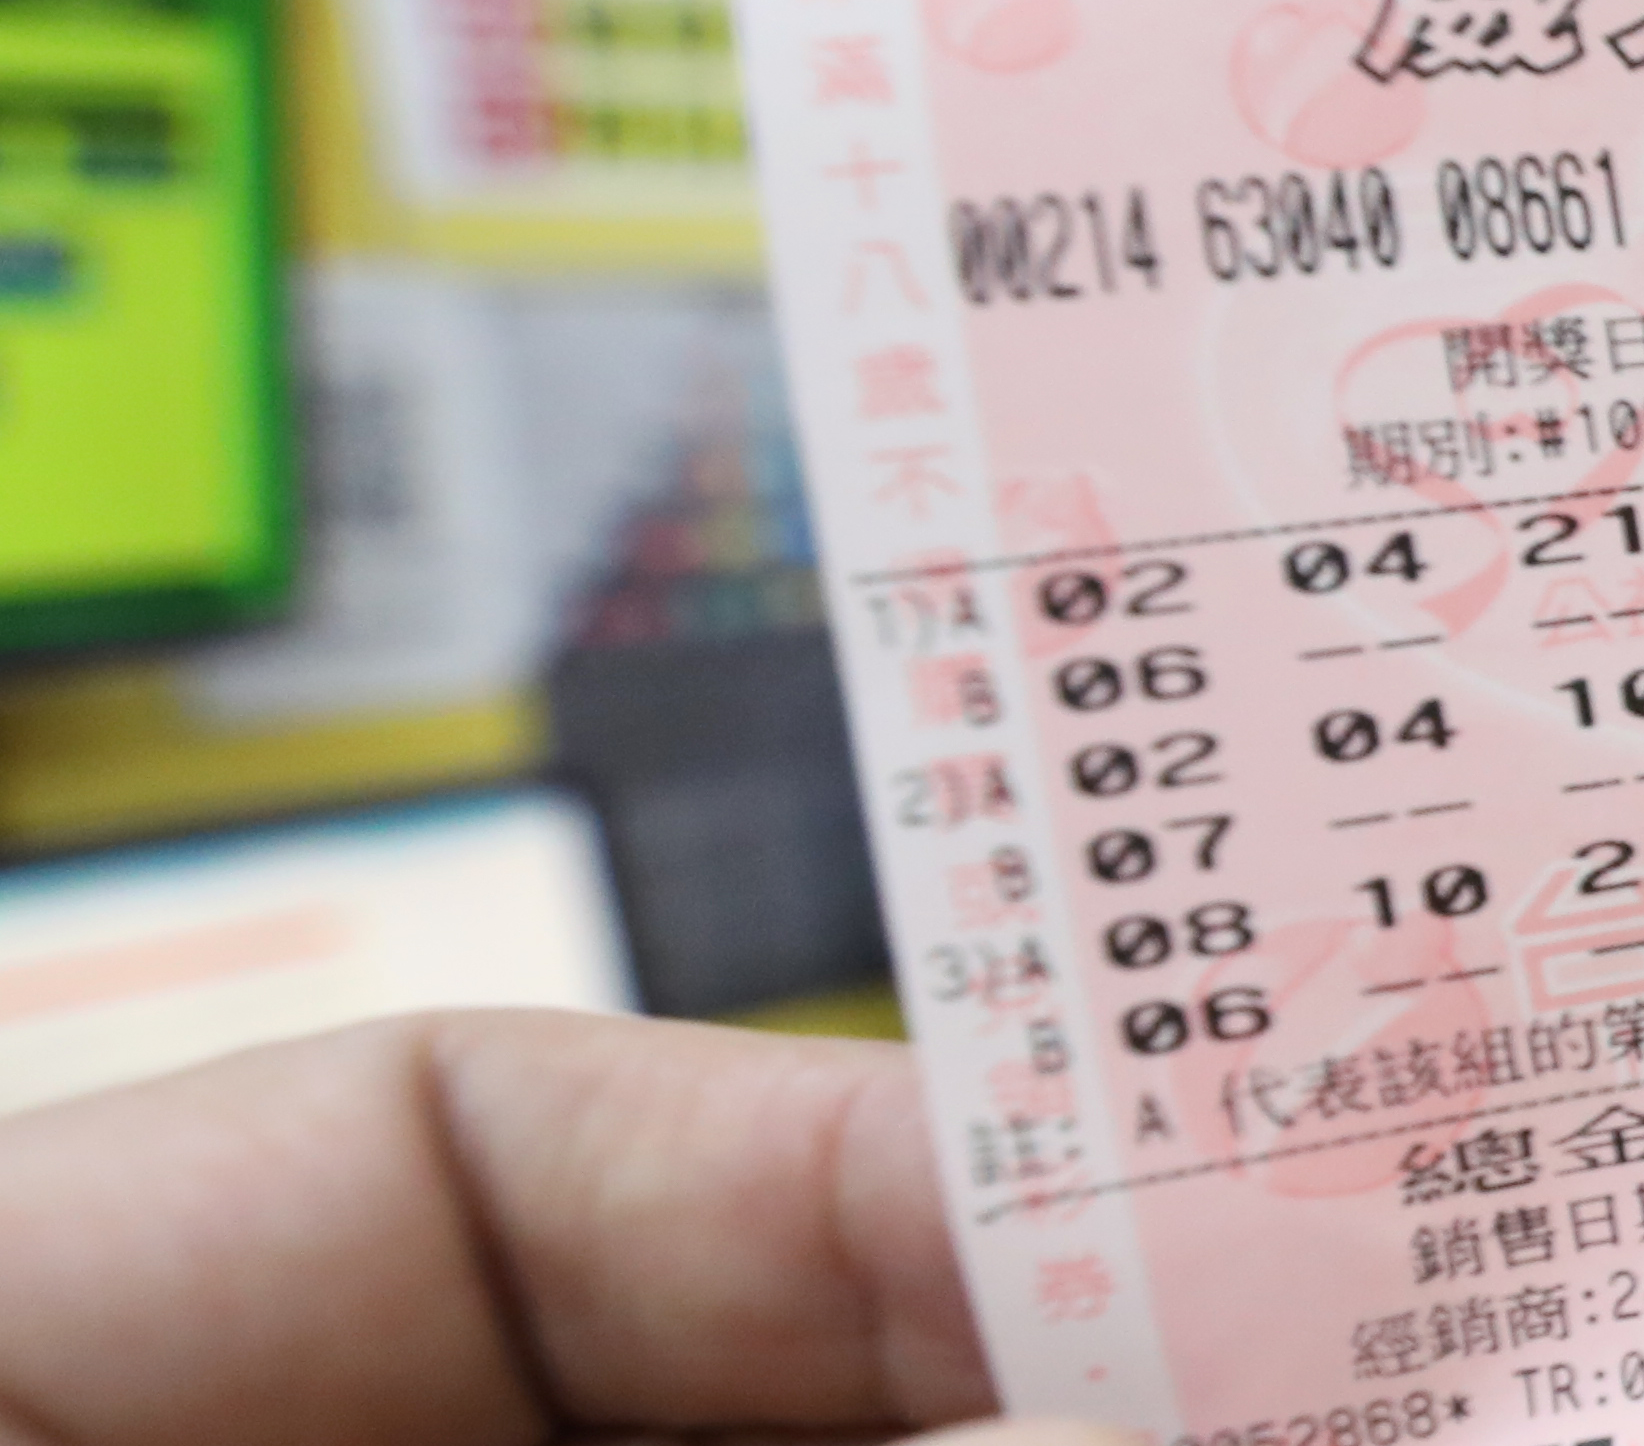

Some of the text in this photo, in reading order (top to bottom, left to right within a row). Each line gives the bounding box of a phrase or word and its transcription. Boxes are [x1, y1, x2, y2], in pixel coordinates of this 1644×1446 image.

[950, 185, 1163, 306] 00214
[1200, 166, 1398, 282] 63040
[1438, 148, 1627, 260] 08661
[1037, 559, 1196, 626] 02
[1284, 531, 1429, 595] 04
[1055, 645, 1210, 713] 06
[1070, 730, 1230, 799] 02
[1312, 697, 1460, 763] 04
[1084, 813, 1237, 886] 07
[1103, 900, 1258, 970] 08
[1356, 862, 1492, 931] 10
[1120, 985, 1276, 1057] 06
[1136, 1090, 1175, 1145] A
